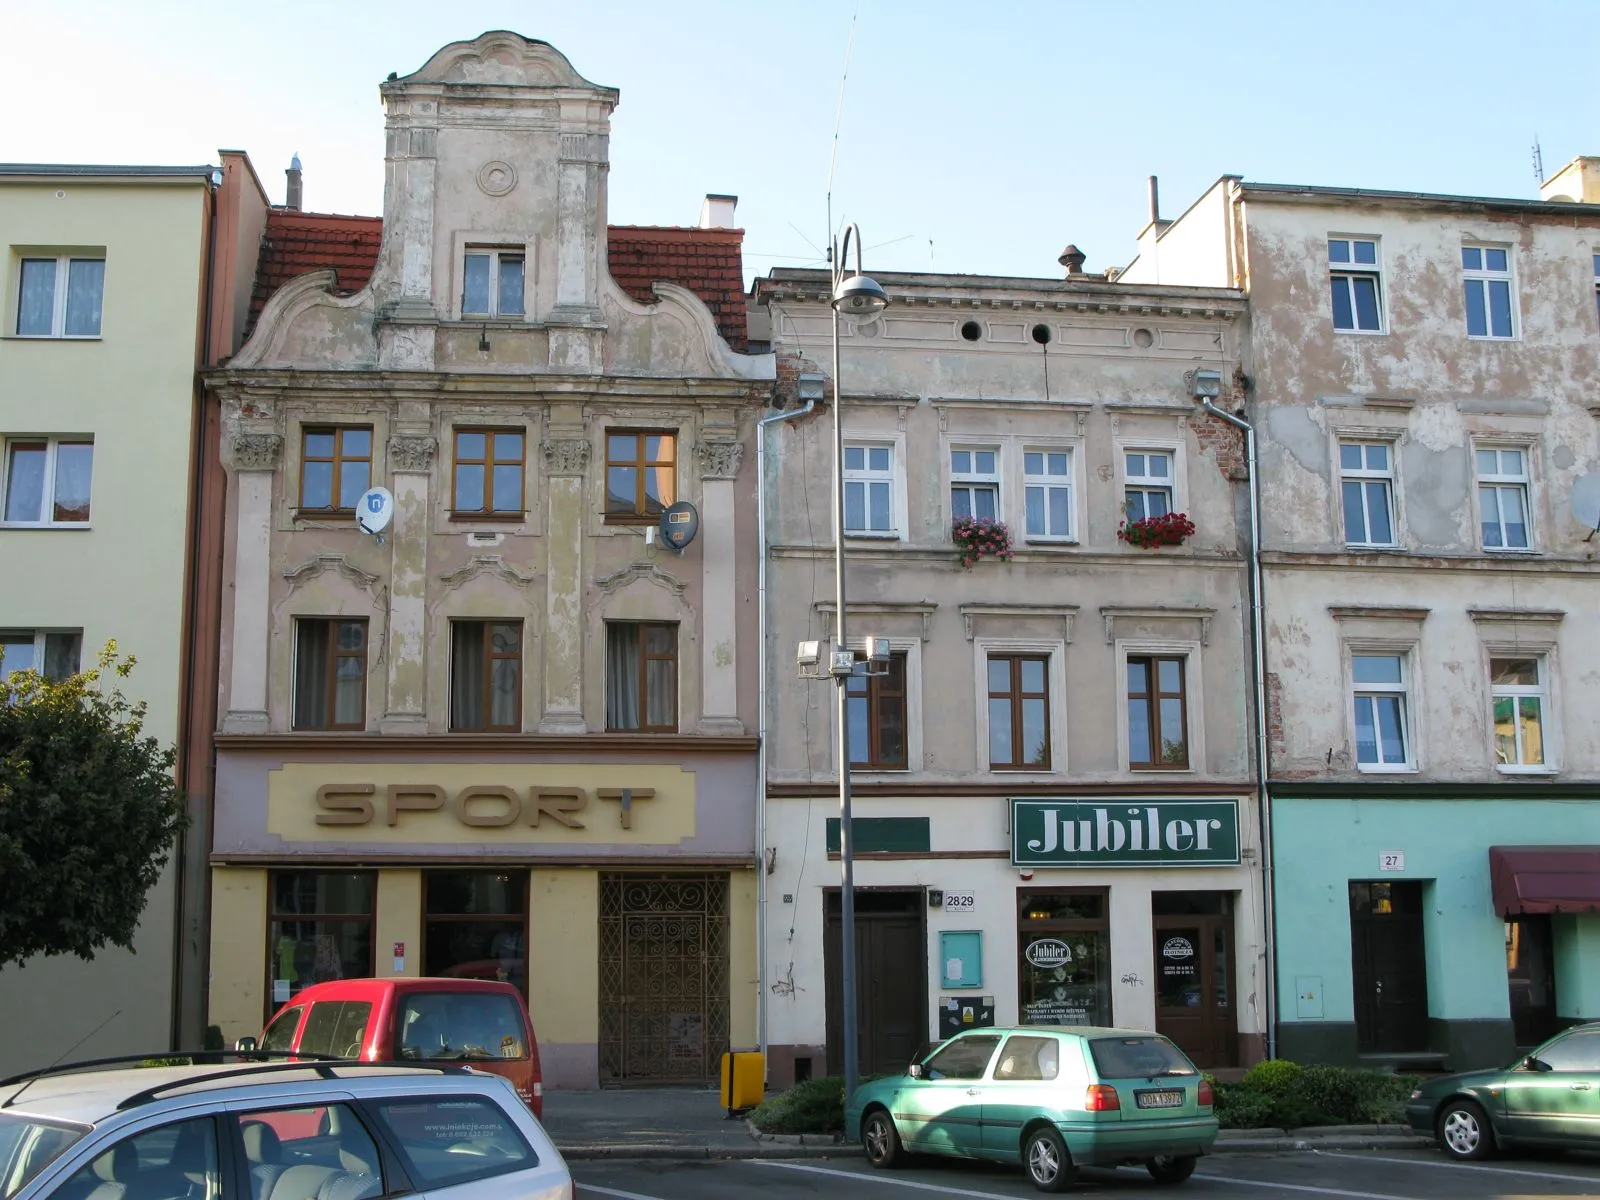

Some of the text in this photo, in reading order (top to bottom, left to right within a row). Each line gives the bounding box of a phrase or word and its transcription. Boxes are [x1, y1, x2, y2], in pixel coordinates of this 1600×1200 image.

[315, 783, 656, 829] SPORT
[1027, 807, 1222, 853] Jubiler
[1385, 856, 1398, 865] 27
[1033, 944, 1065, 957] Jubiler
